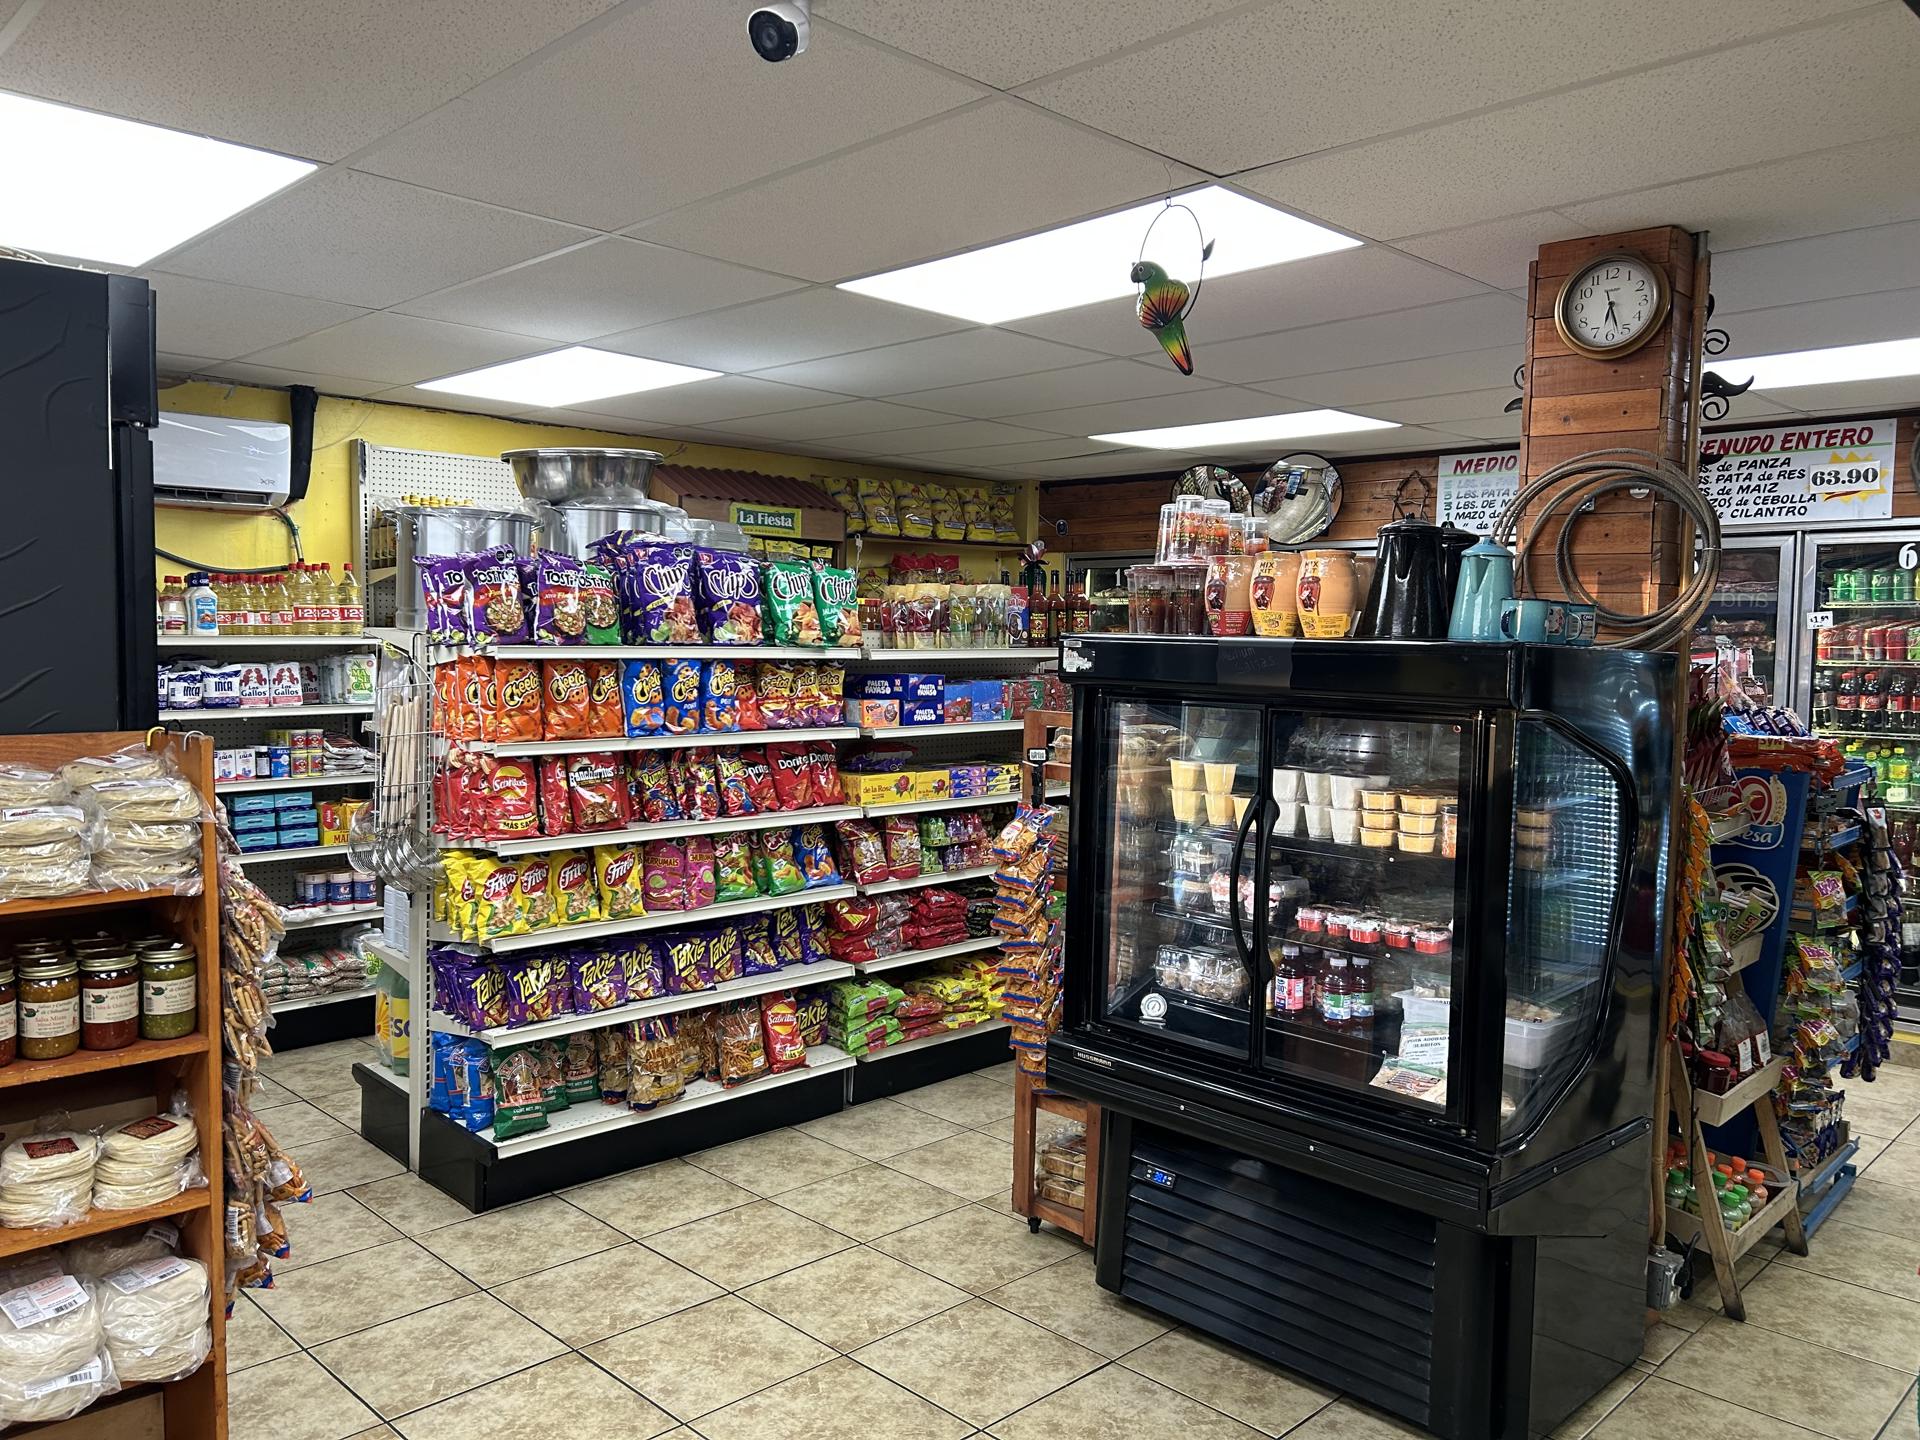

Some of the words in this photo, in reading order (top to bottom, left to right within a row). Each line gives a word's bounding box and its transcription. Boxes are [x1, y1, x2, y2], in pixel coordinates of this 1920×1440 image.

[1605, 267, 1620, 280] 12
[1627, 270, 1631, 281] 1
[1591, 275, 1600, 286] 11
[1635, 280, 1645, 292] 2
[1580, 287, 1593, 299] 10
[1638, 294, 1649, 306] 3
[1574, 302, 1584, 313] 9
[1632, 310, 1641, 321] 4
[1578, 317, 1588, 328] 8
[1620, 323, 1631, 335] 5
[1590, 327, 1600, 339] 7
[1605, 329, 1615, 341] 6
[1700, 434, 1775, 456] ENUDO
[1779, 426, 1874, 451] ENTERO
[1453, 455, 1518, 475] MEDIO
[1717, 461, 1733, 473] de
[1737, 457, 1791, 471] PANZA
[1715, 473, 1752, 484] PATA
[1757, 470, 1774, 481] de
[1776, 468, 1806, 480] RES
[1811, 467, 1879, 487] 63.90
[1456, 489, 1478, 500] LBS.
[1481, 488, 1510, 498] PATA
[1716, 484, 1733, 496] de
[1736, 482, 1779, 495] MAIZ
[1455, 500, 1478, 510] LBS.
[1480, 499, 1496, 509] DE
[1710, 497, 1732, 509] ZOS
[1735, 496, 1749, 507] de
[1752, 493, 1817, 506] CEBOLLA
[740, 510, 754, 524] La
[757, 512, 793, 527] Fiesta
[1445, 512, 1450, 520] 1
[1454, 510, 1486, 521] MAZO
[1730, 505, 1808, 519] CILANTRO
[1476, 520, 1489, 530] de
[1898, 542, 1918, 570] 6
[183, 686, 200, 696] INCA
[215, 681, 233, 692] INCA
[241, 689, 267, 697] Gallos
[274, 688, 299, 696] Gallos
[559, 860, 588, 890] Fritos
[606, 853, 635, 886] Fritos
[484, 869, 518, 899] Fritos
[521, 865, 548, 892] Fritos
[708, 929, 738, 969] Takis
[670, 940, 707, 976] Takis
[619, 949, 654, 982] Takis
[579, 953, 617, 992] Takis
[514, 960, 551, 1003] Takis
[471, 967, 506, 1011] Takis
